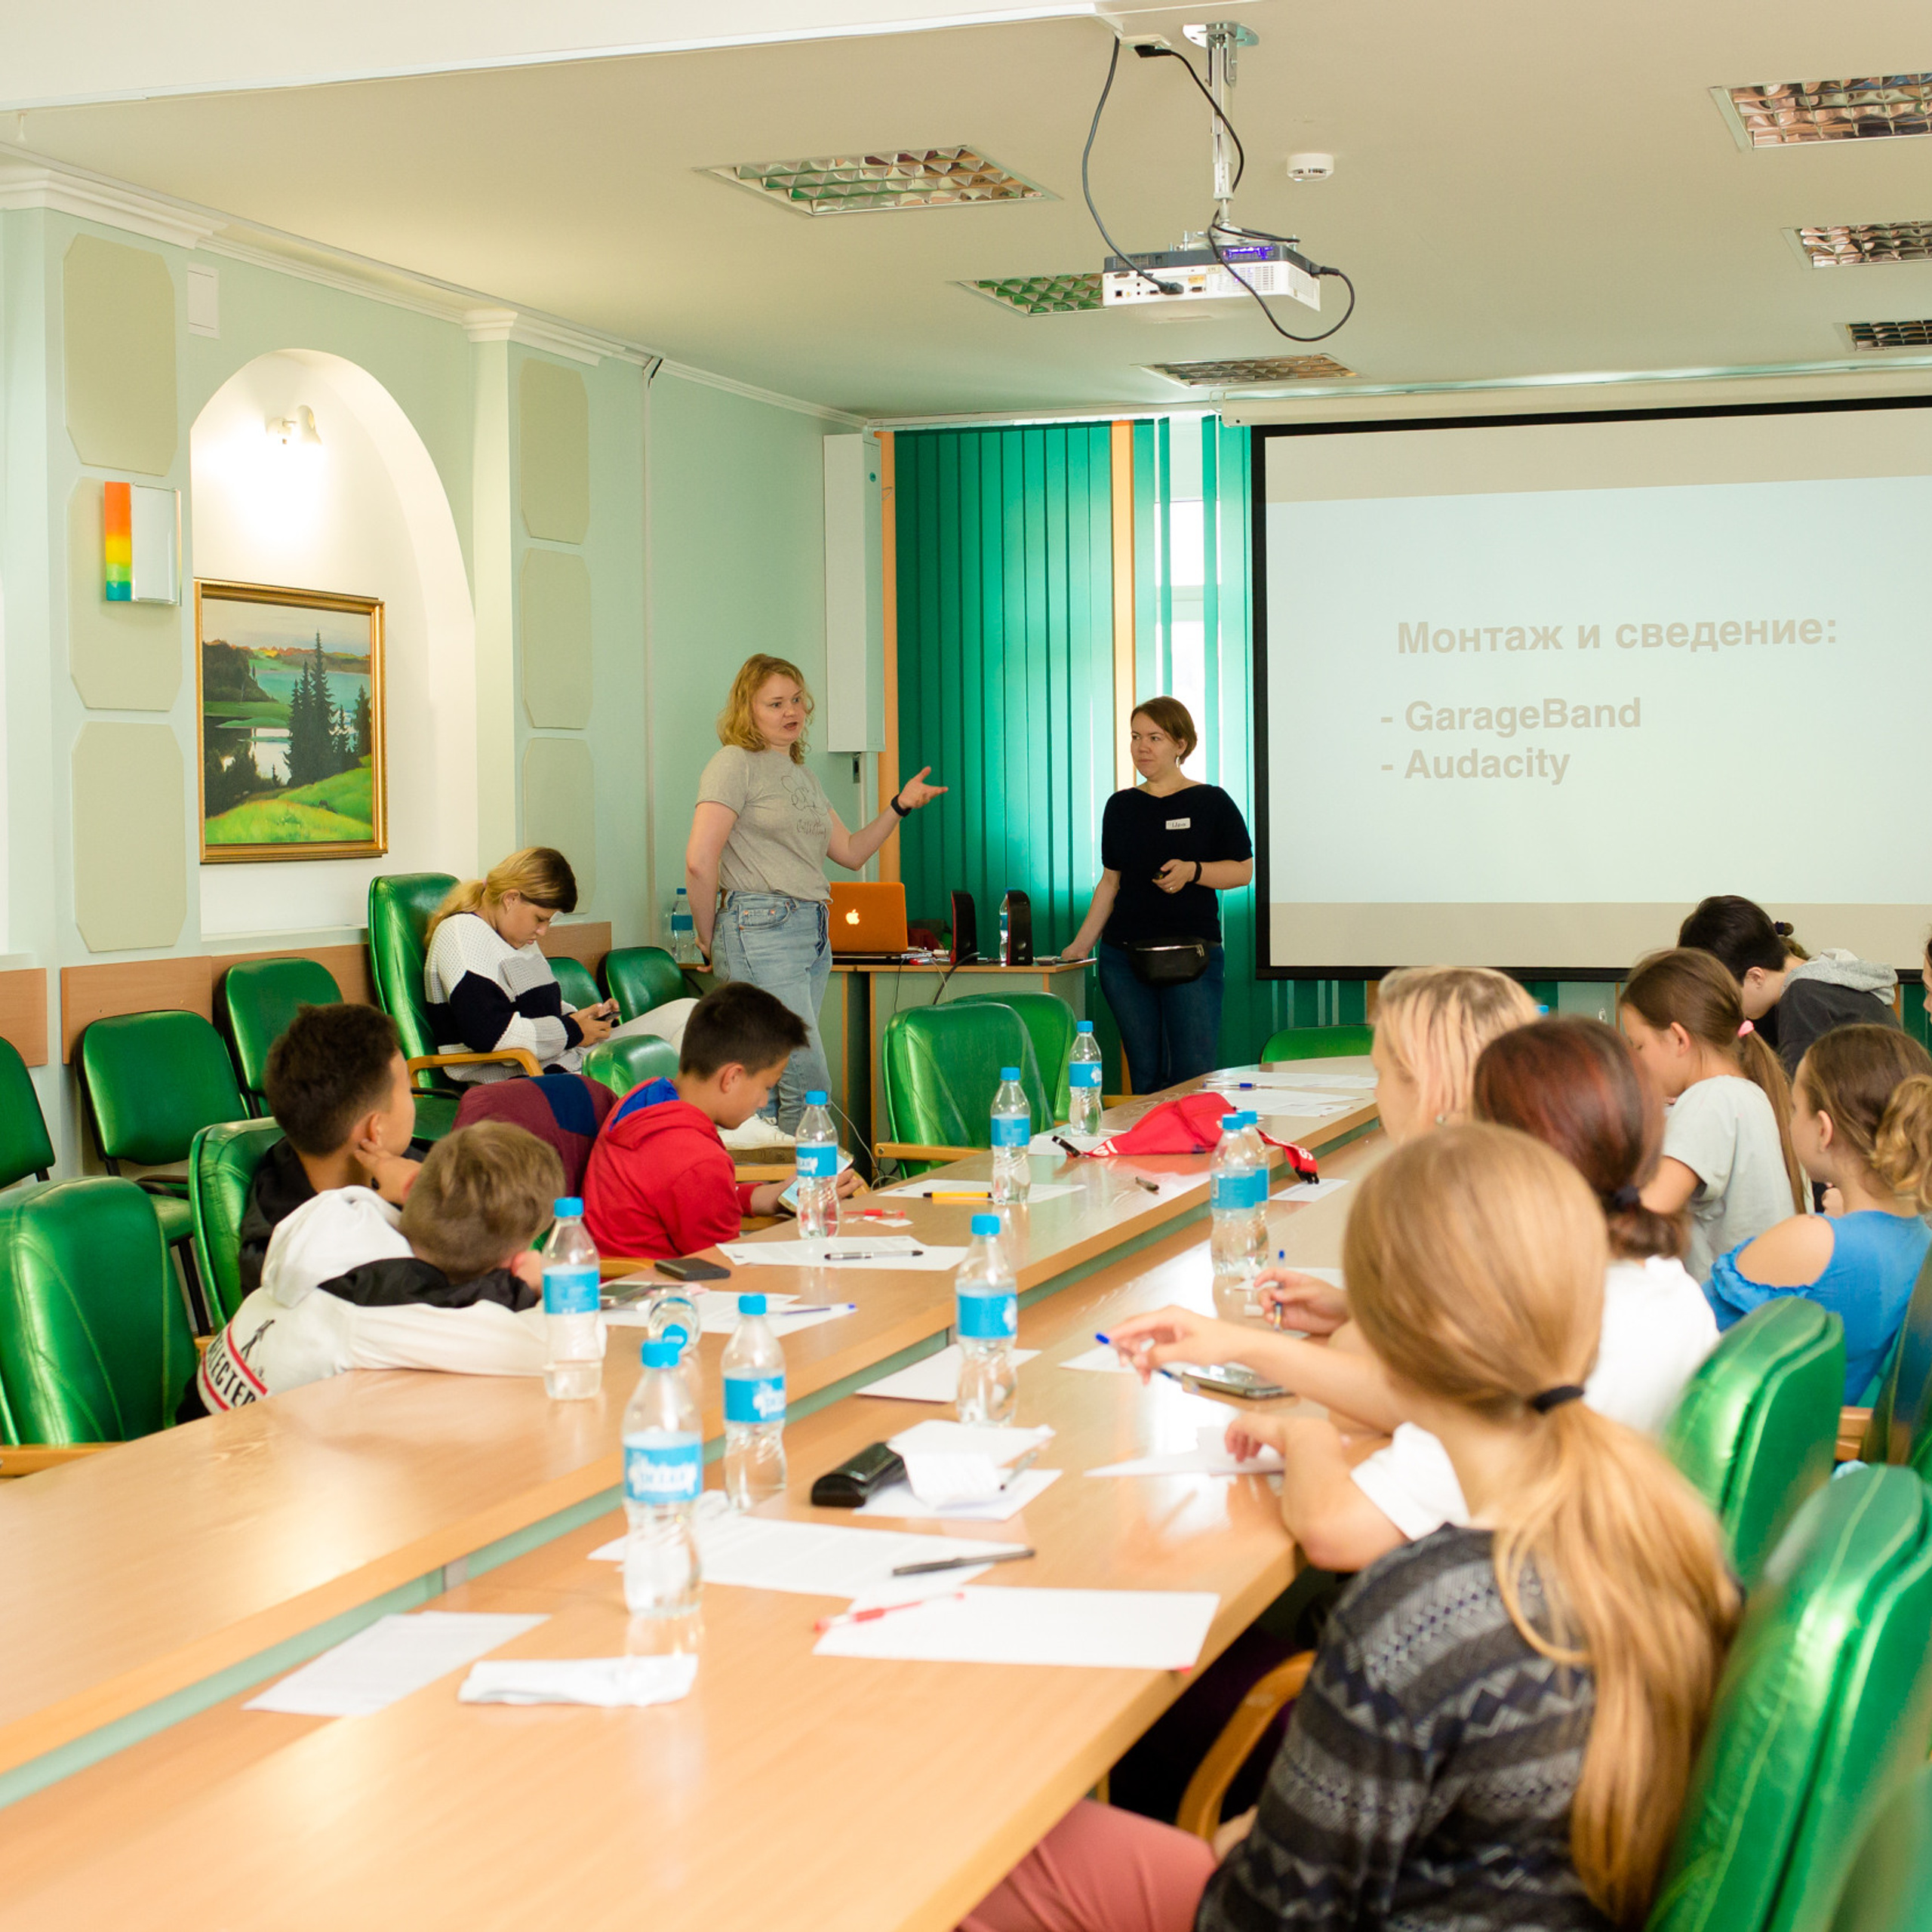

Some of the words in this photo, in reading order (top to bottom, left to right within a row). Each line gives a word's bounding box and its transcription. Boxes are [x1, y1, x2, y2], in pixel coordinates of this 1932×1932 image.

[1398, 621, 1563, 654] Монтаж
[1577, 624, 1601, 650] и
[1615, 618, 1836, 653] сведение:
[1405, 697, 1641, 738] GarageBand
[1404, 746, 1571, 786] Audacity
